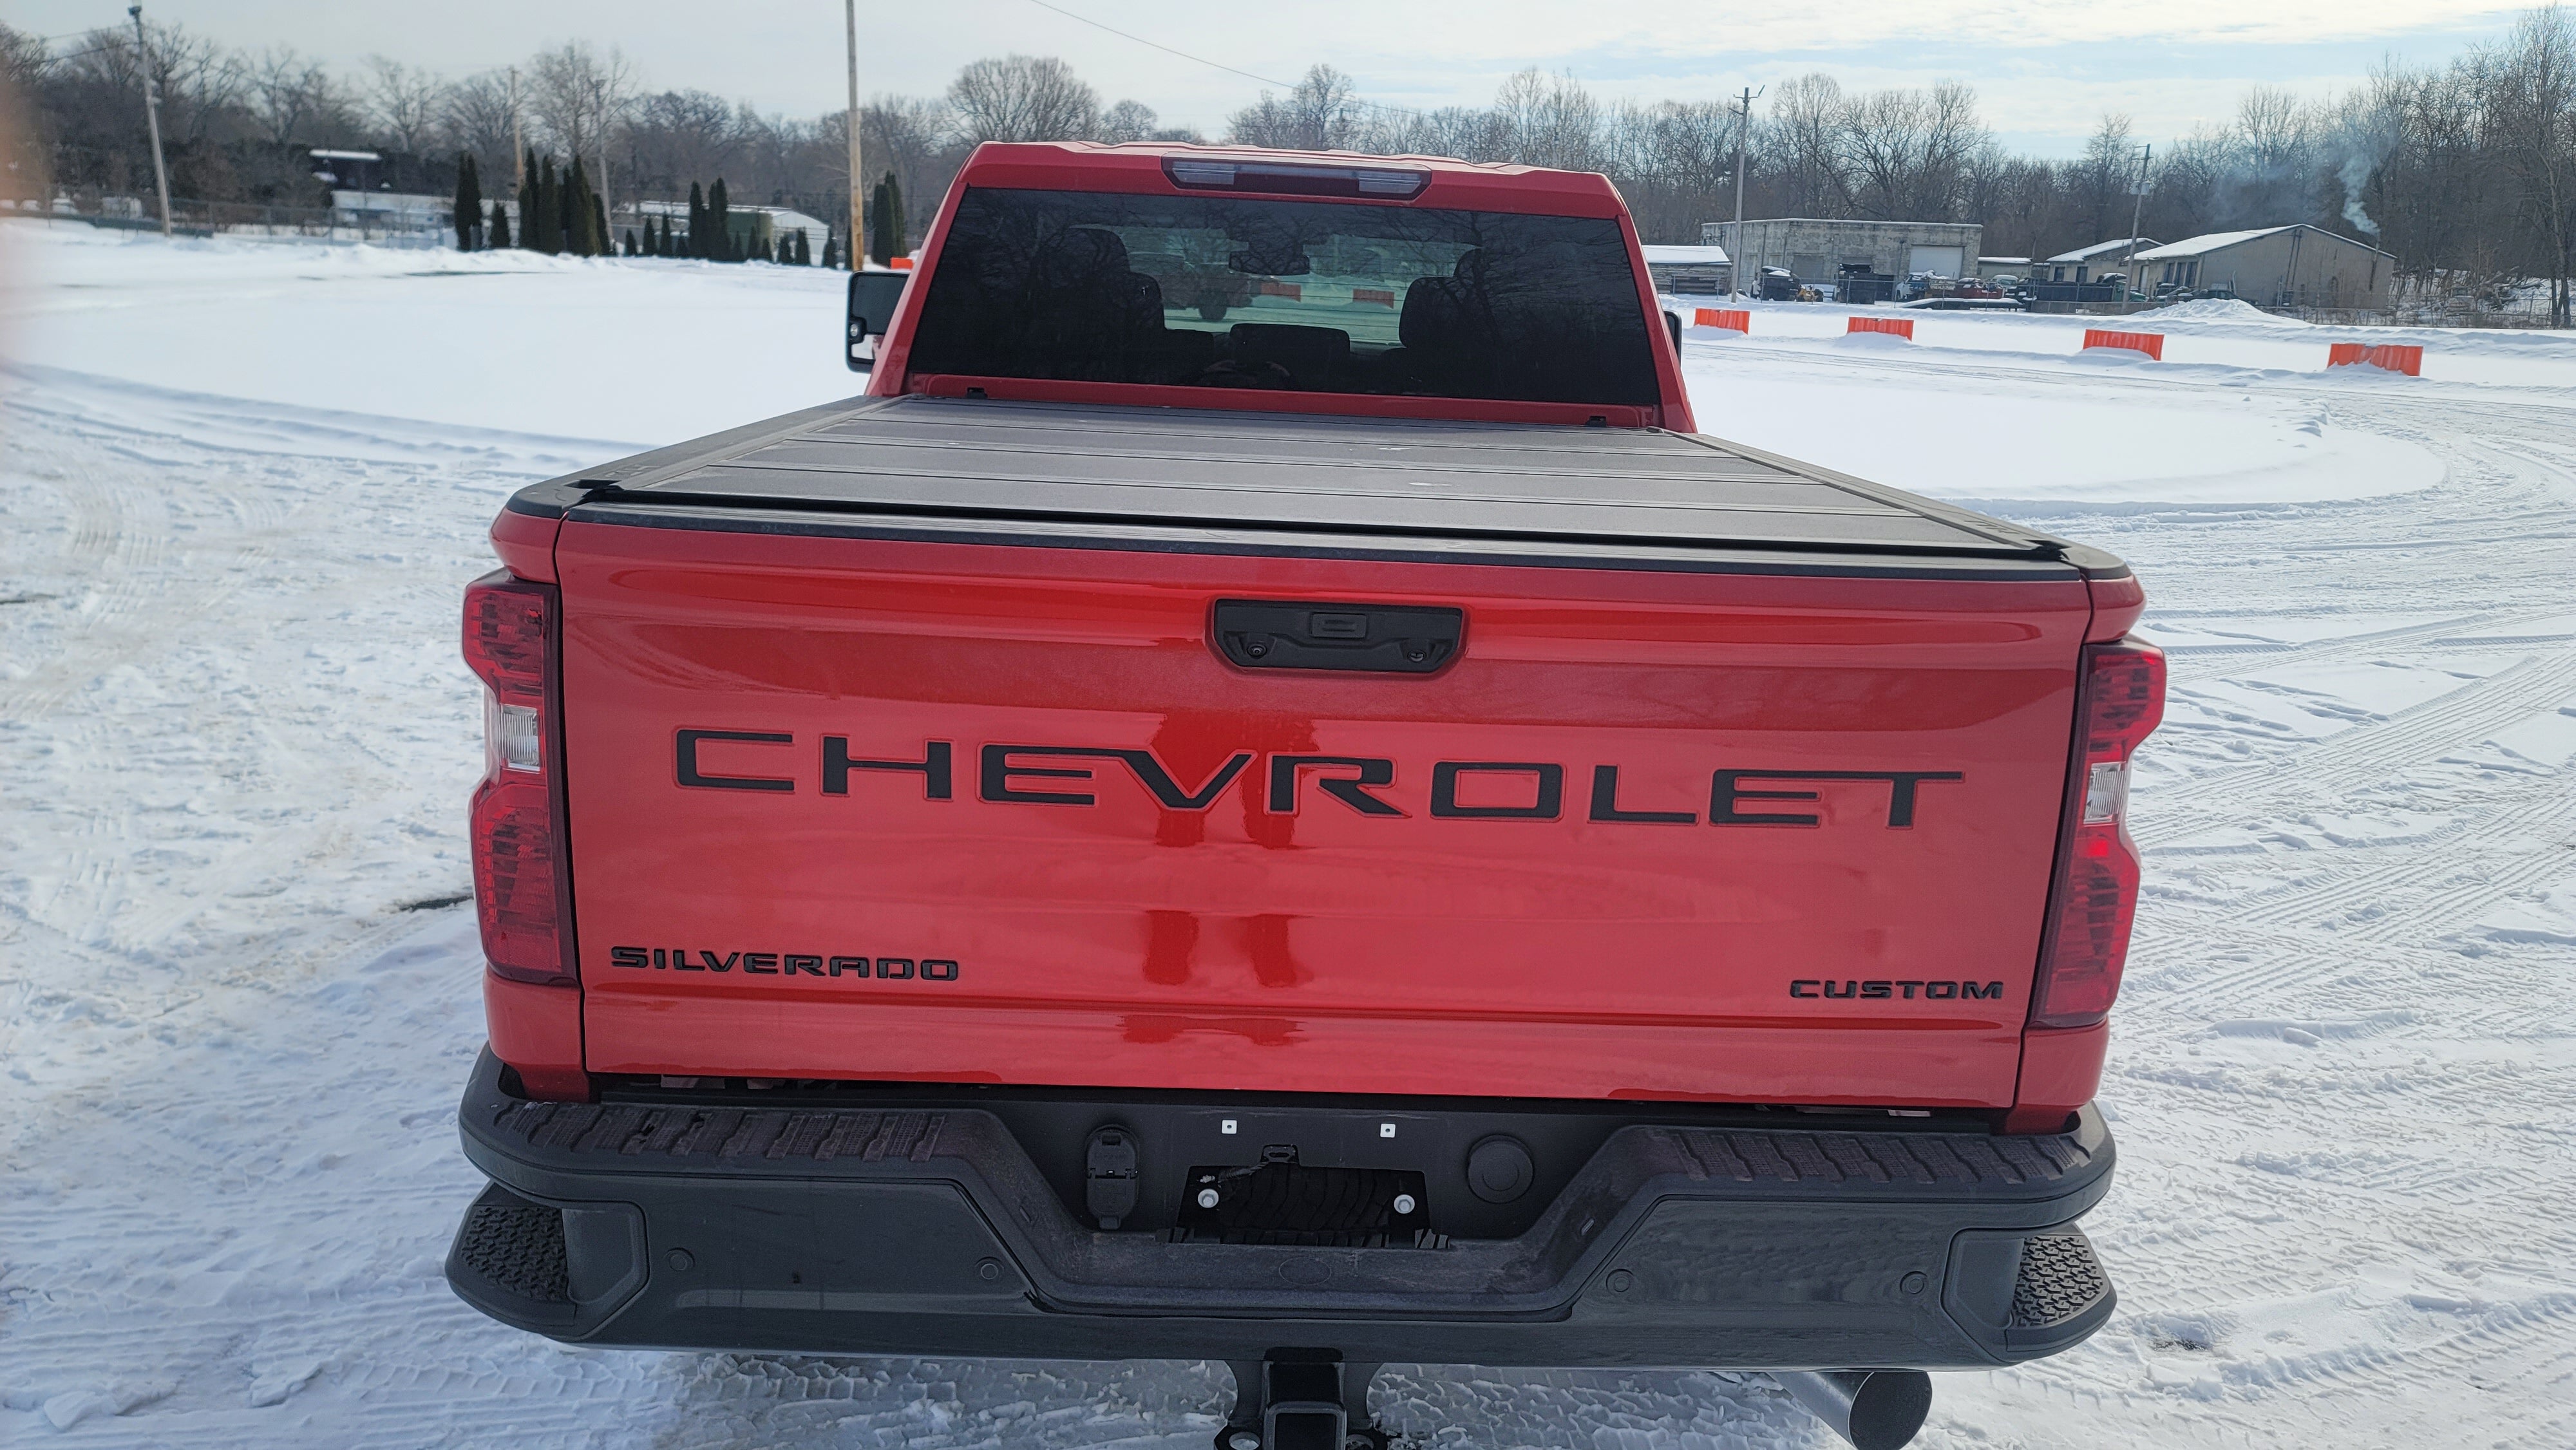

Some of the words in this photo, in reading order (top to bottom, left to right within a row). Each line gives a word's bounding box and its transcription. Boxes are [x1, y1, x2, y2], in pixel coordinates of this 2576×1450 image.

[675, 728, 1964, 829] CHEVROLET
[611, 945, 959, 981] SILVERADO
[1790, 980, 2003, 999] CUSTOM
